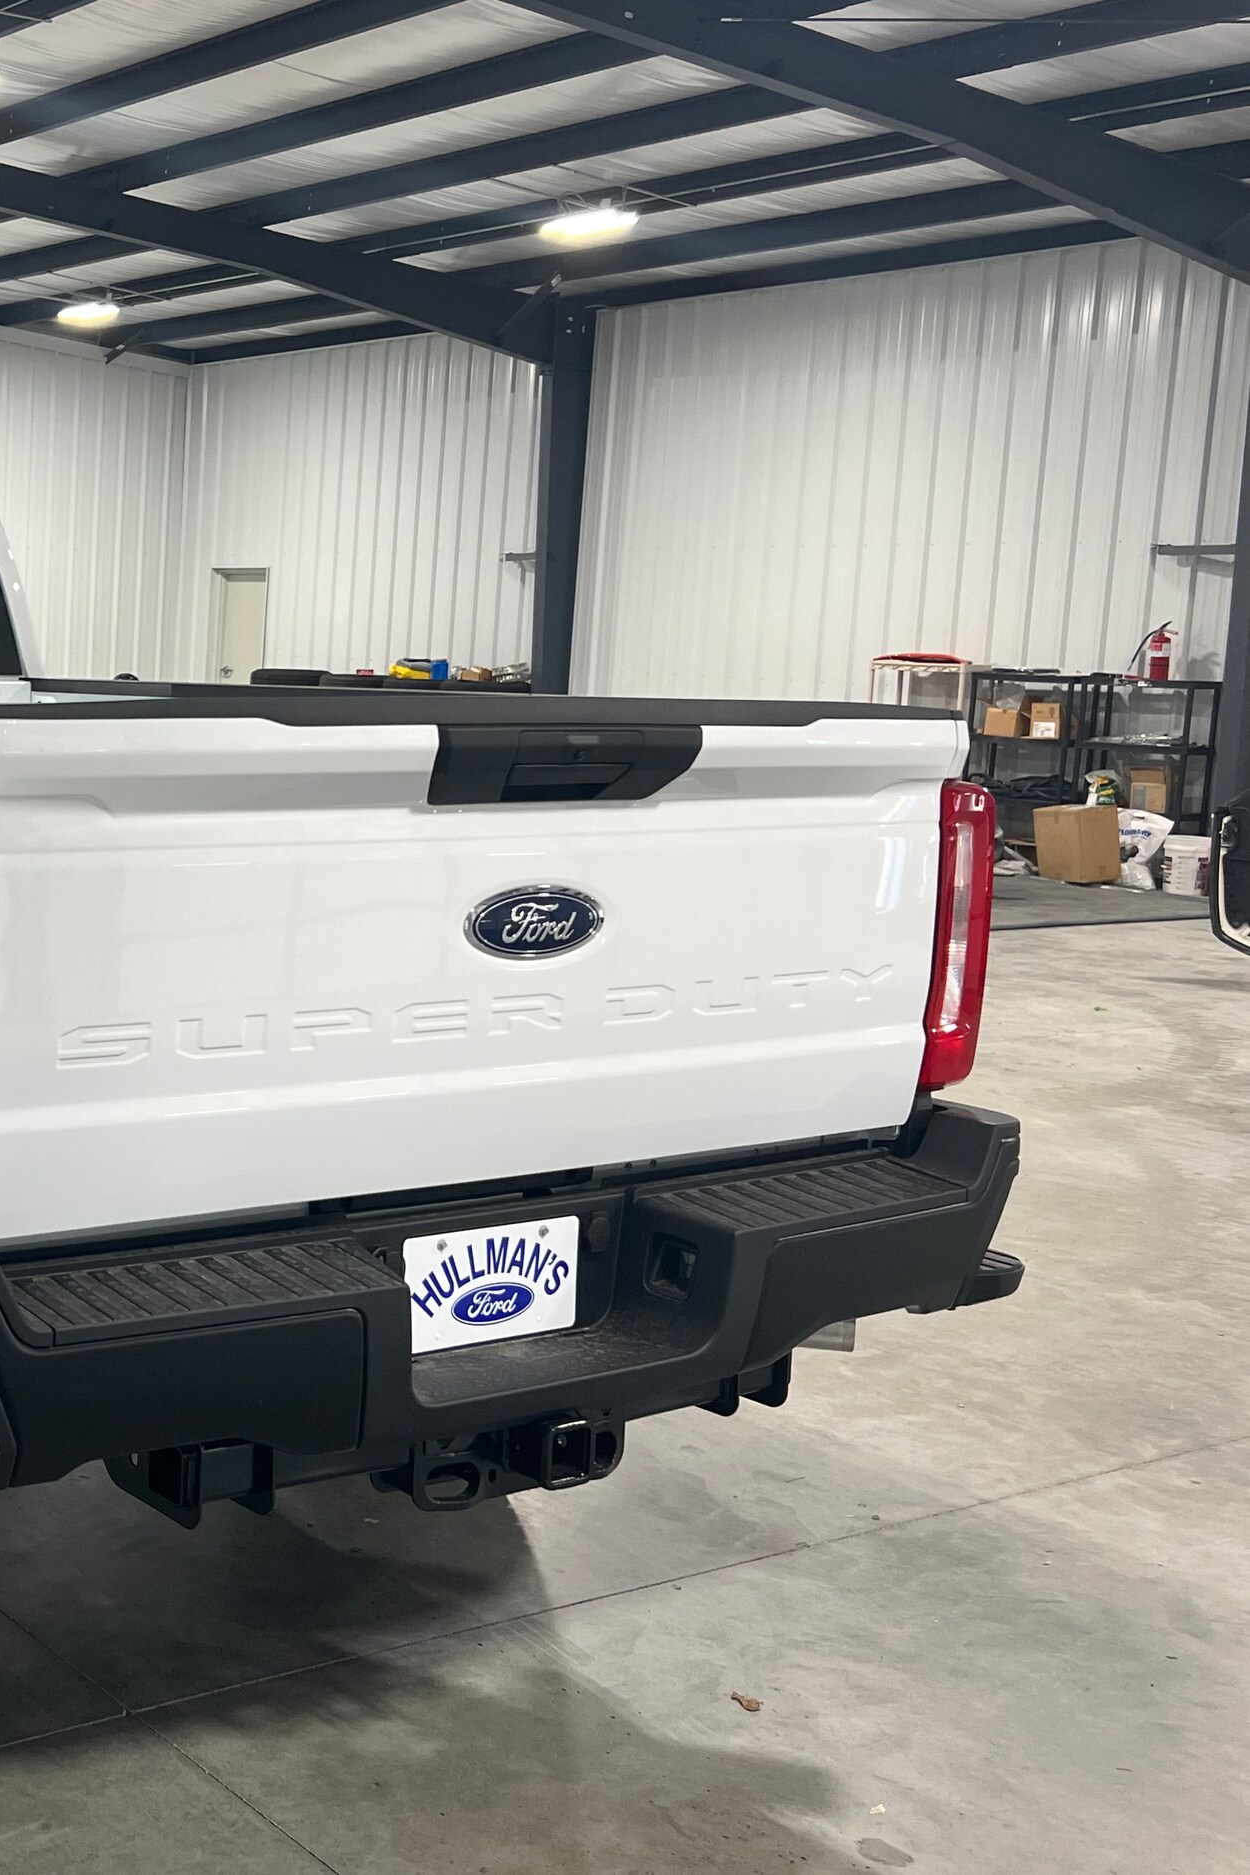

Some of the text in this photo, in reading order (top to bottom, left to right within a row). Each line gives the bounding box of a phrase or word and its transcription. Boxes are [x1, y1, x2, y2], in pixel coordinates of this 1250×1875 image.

[502, 902, 577, 944] Ford
[56, 964, 893, 1069] SUPER DUTY
[411, 1236, 569, 1318] HULLMAN'S
[467, 1288, 519, 1318] Ford
